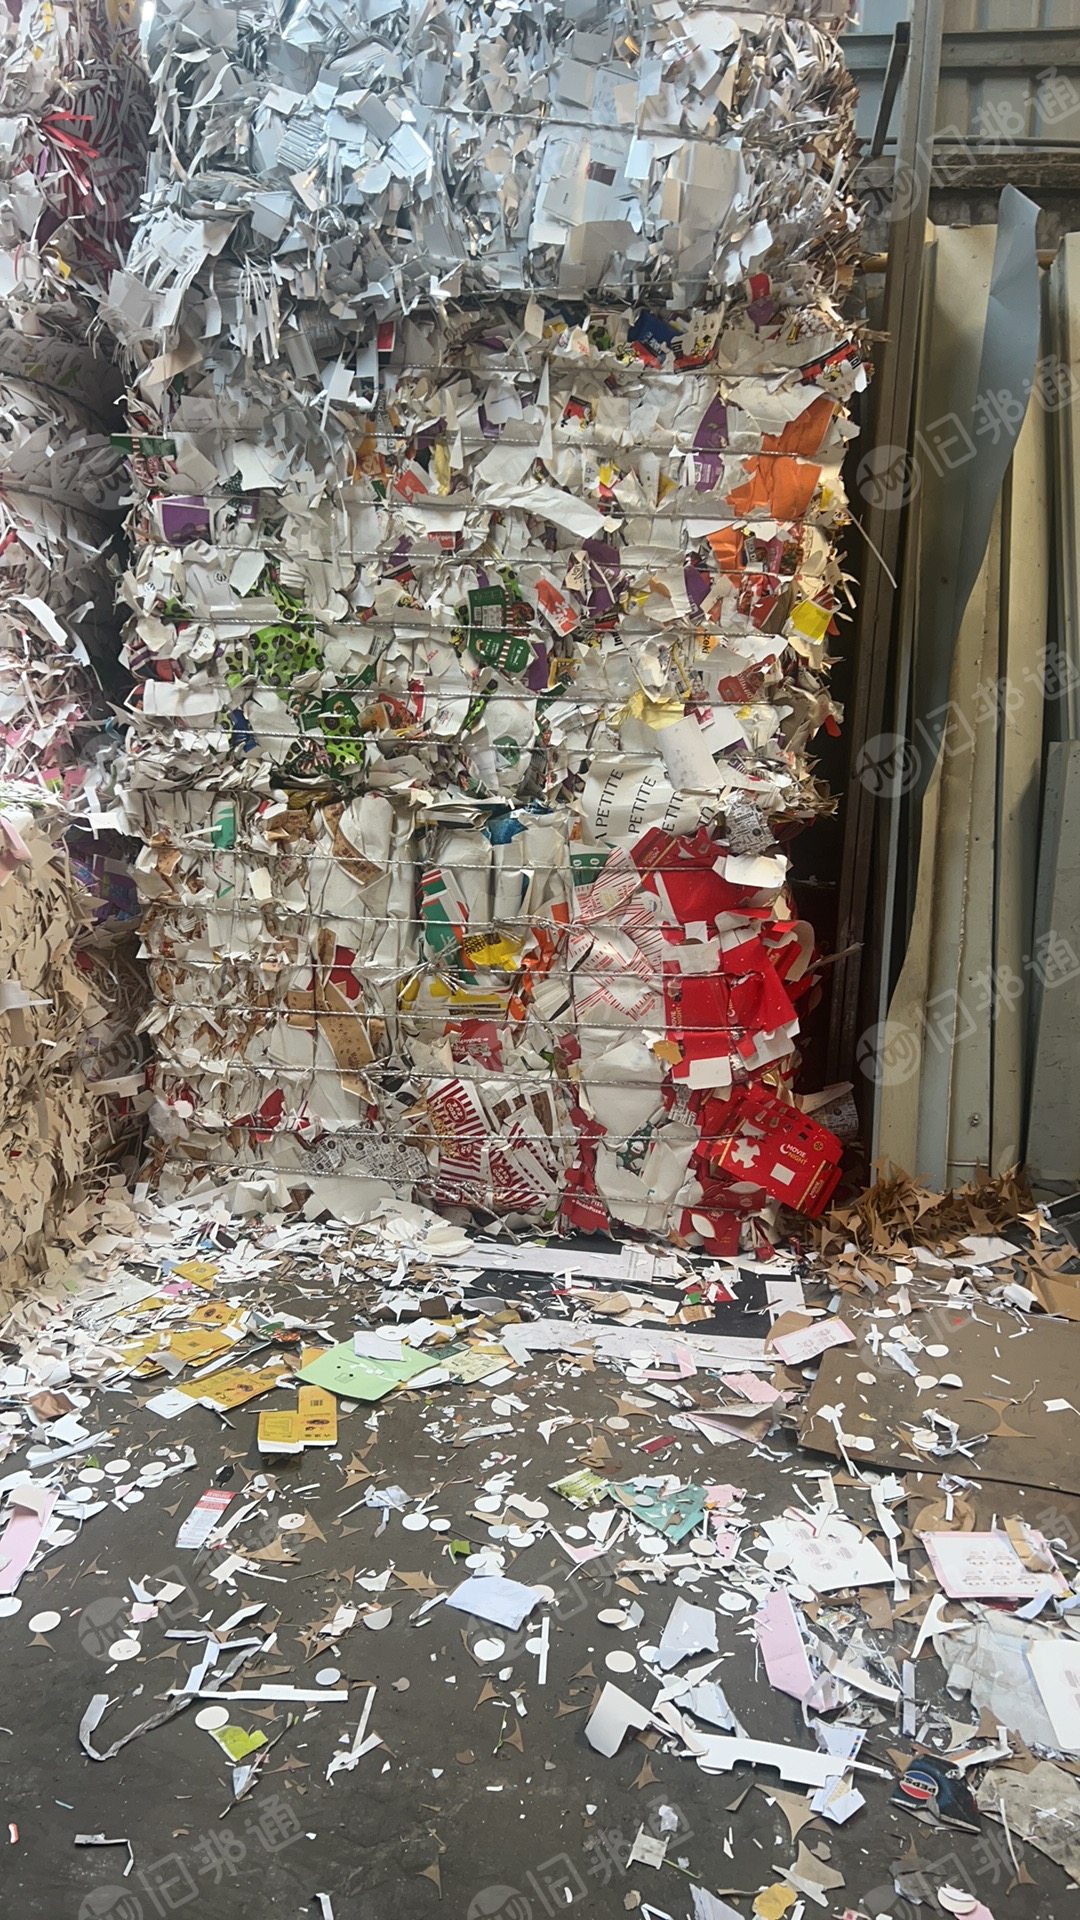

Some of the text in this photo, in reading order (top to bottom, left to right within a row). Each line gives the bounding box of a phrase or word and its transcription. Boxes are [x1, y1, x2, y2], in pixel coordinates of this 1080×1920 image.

[595, 768, 624, 828] PETITE
[628, 775, 657, 834] PETITE
[661, 791, 684, 833] ETIT
[786, 1143, 807, 1159] MOVIE
[787, 1151, 808, 1165] NIGHT
